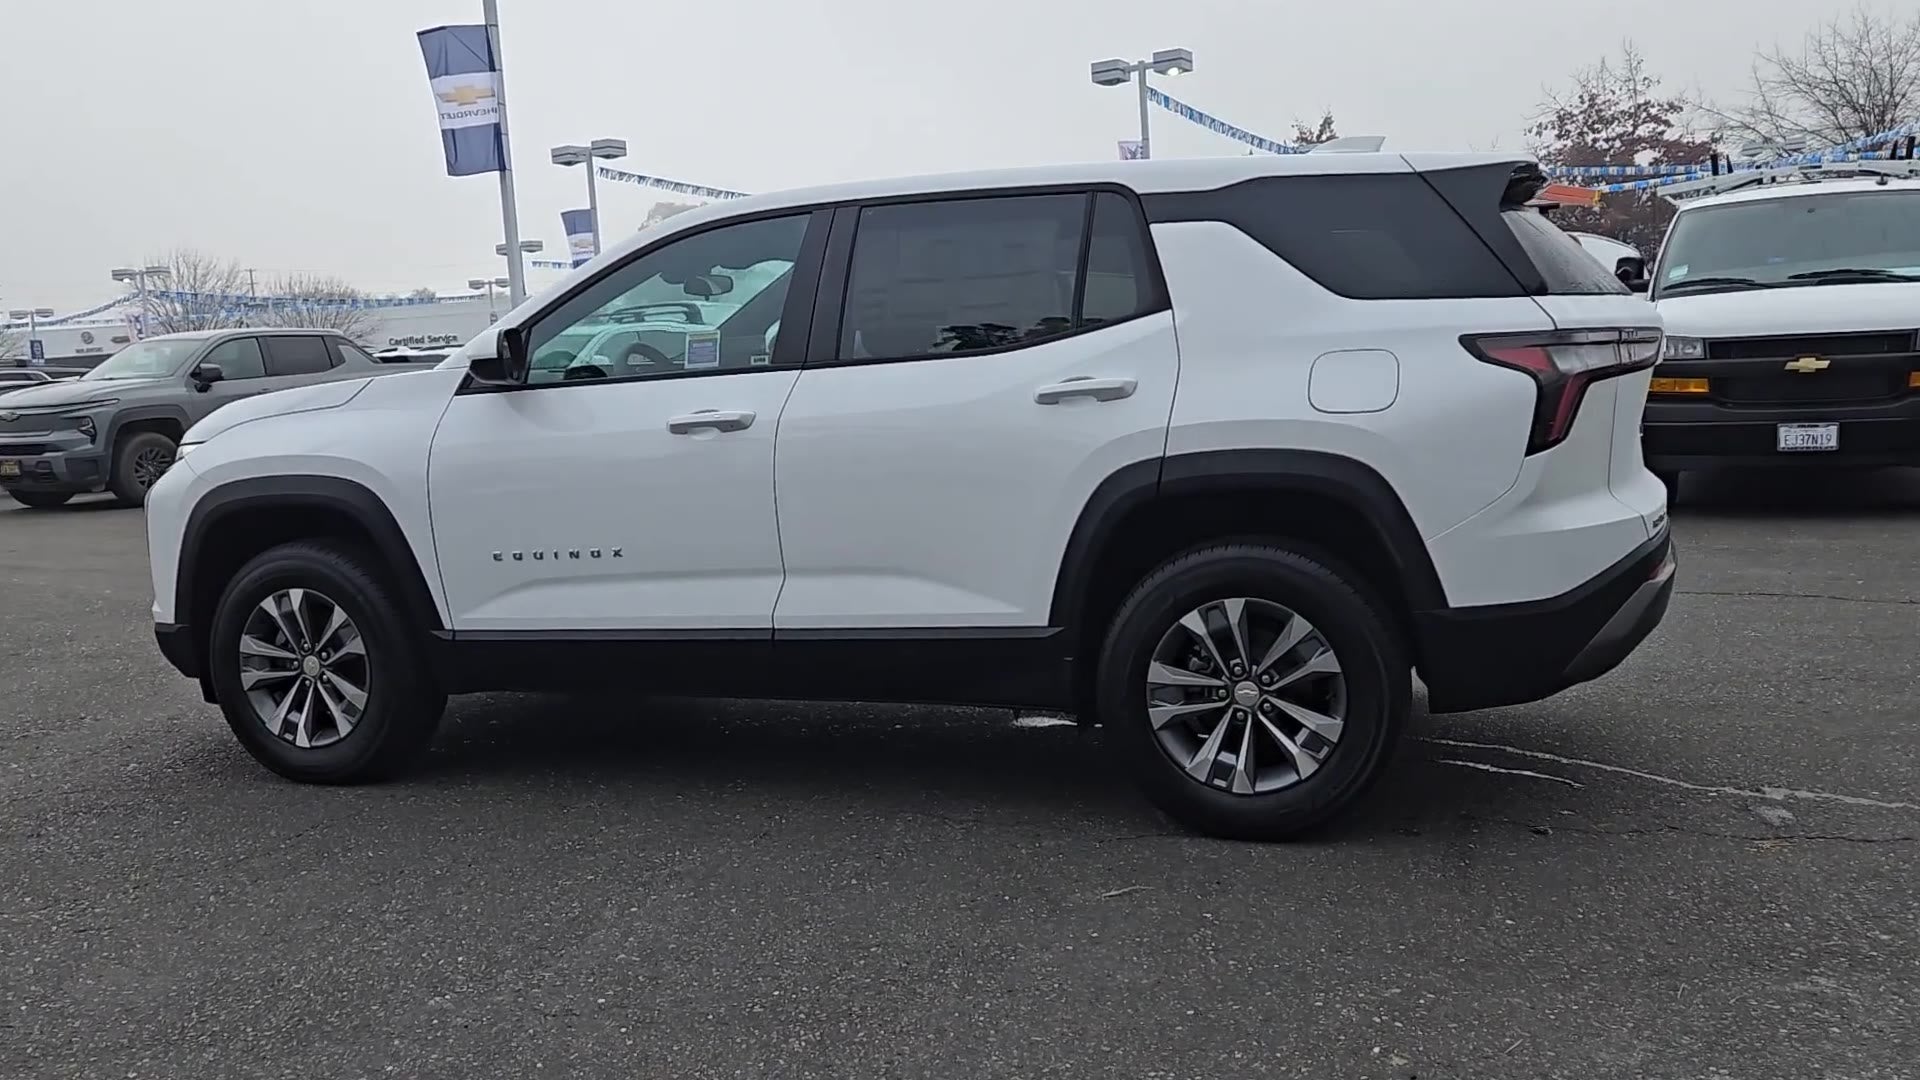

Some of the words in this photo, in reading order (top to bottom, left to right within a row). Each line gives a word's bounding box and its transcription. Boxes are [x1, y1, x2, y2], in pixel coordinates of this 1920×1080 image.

[389, 335, 425, 346] Certified
[427, 334, 458, 344] Service
[493, 547, 624, 562] EQUINOX
